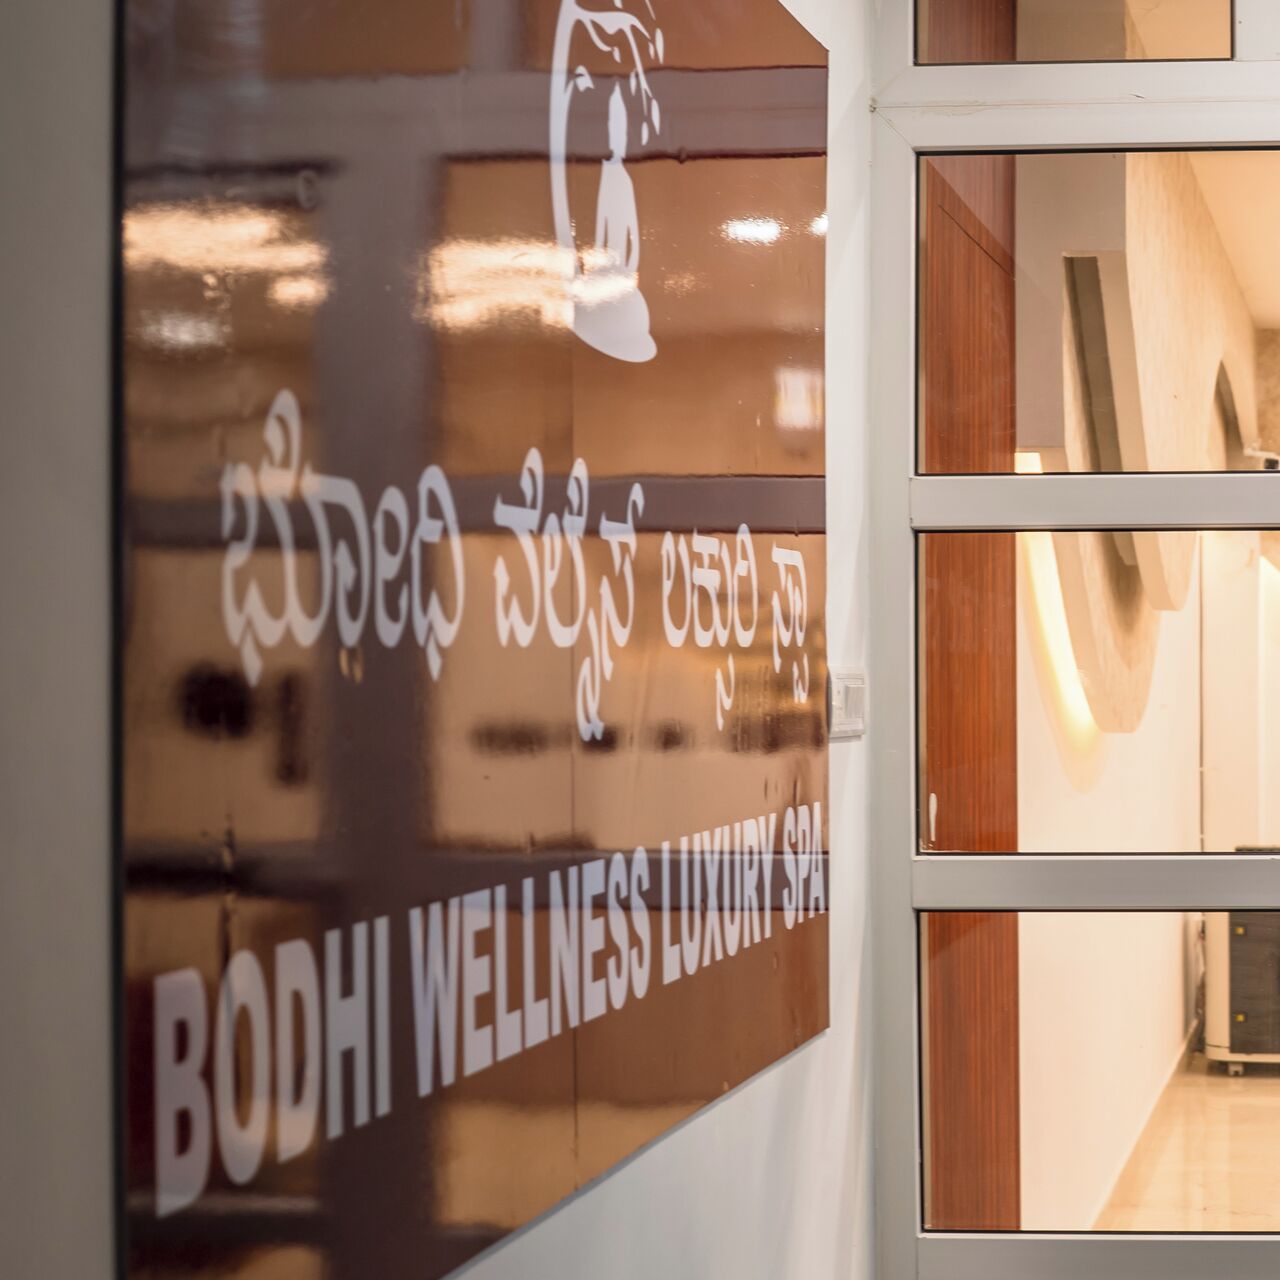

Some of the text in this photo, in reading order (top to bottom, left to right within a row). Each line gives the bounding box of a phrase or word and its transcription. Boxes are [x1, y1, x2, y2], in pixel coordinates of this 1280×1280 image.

[153, 800, 827, 1220] BODHI WELLNESS LUXURY SPA
